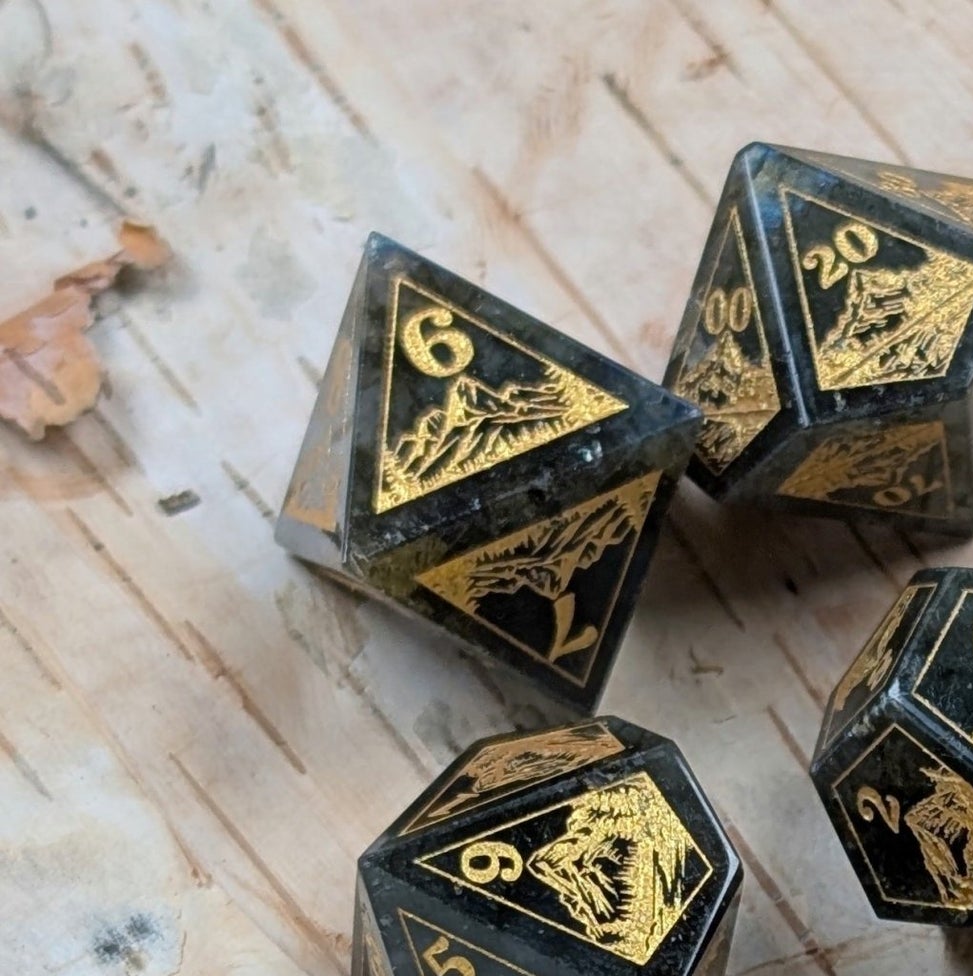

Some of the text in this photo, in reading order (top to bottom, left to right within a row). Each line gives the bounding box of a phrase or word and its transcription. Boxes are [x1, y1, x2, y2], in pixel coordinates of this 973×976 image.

[803, 223, 879, 289] 20
[705, 287, 752, 335] 00
[401, 308, 475, 377] 6
[873, 475, 944, 507] 10
[548, 592, 598, 662] 7
[857, 786, 900, 834] 2
[460, 840, 524, 885] 9
